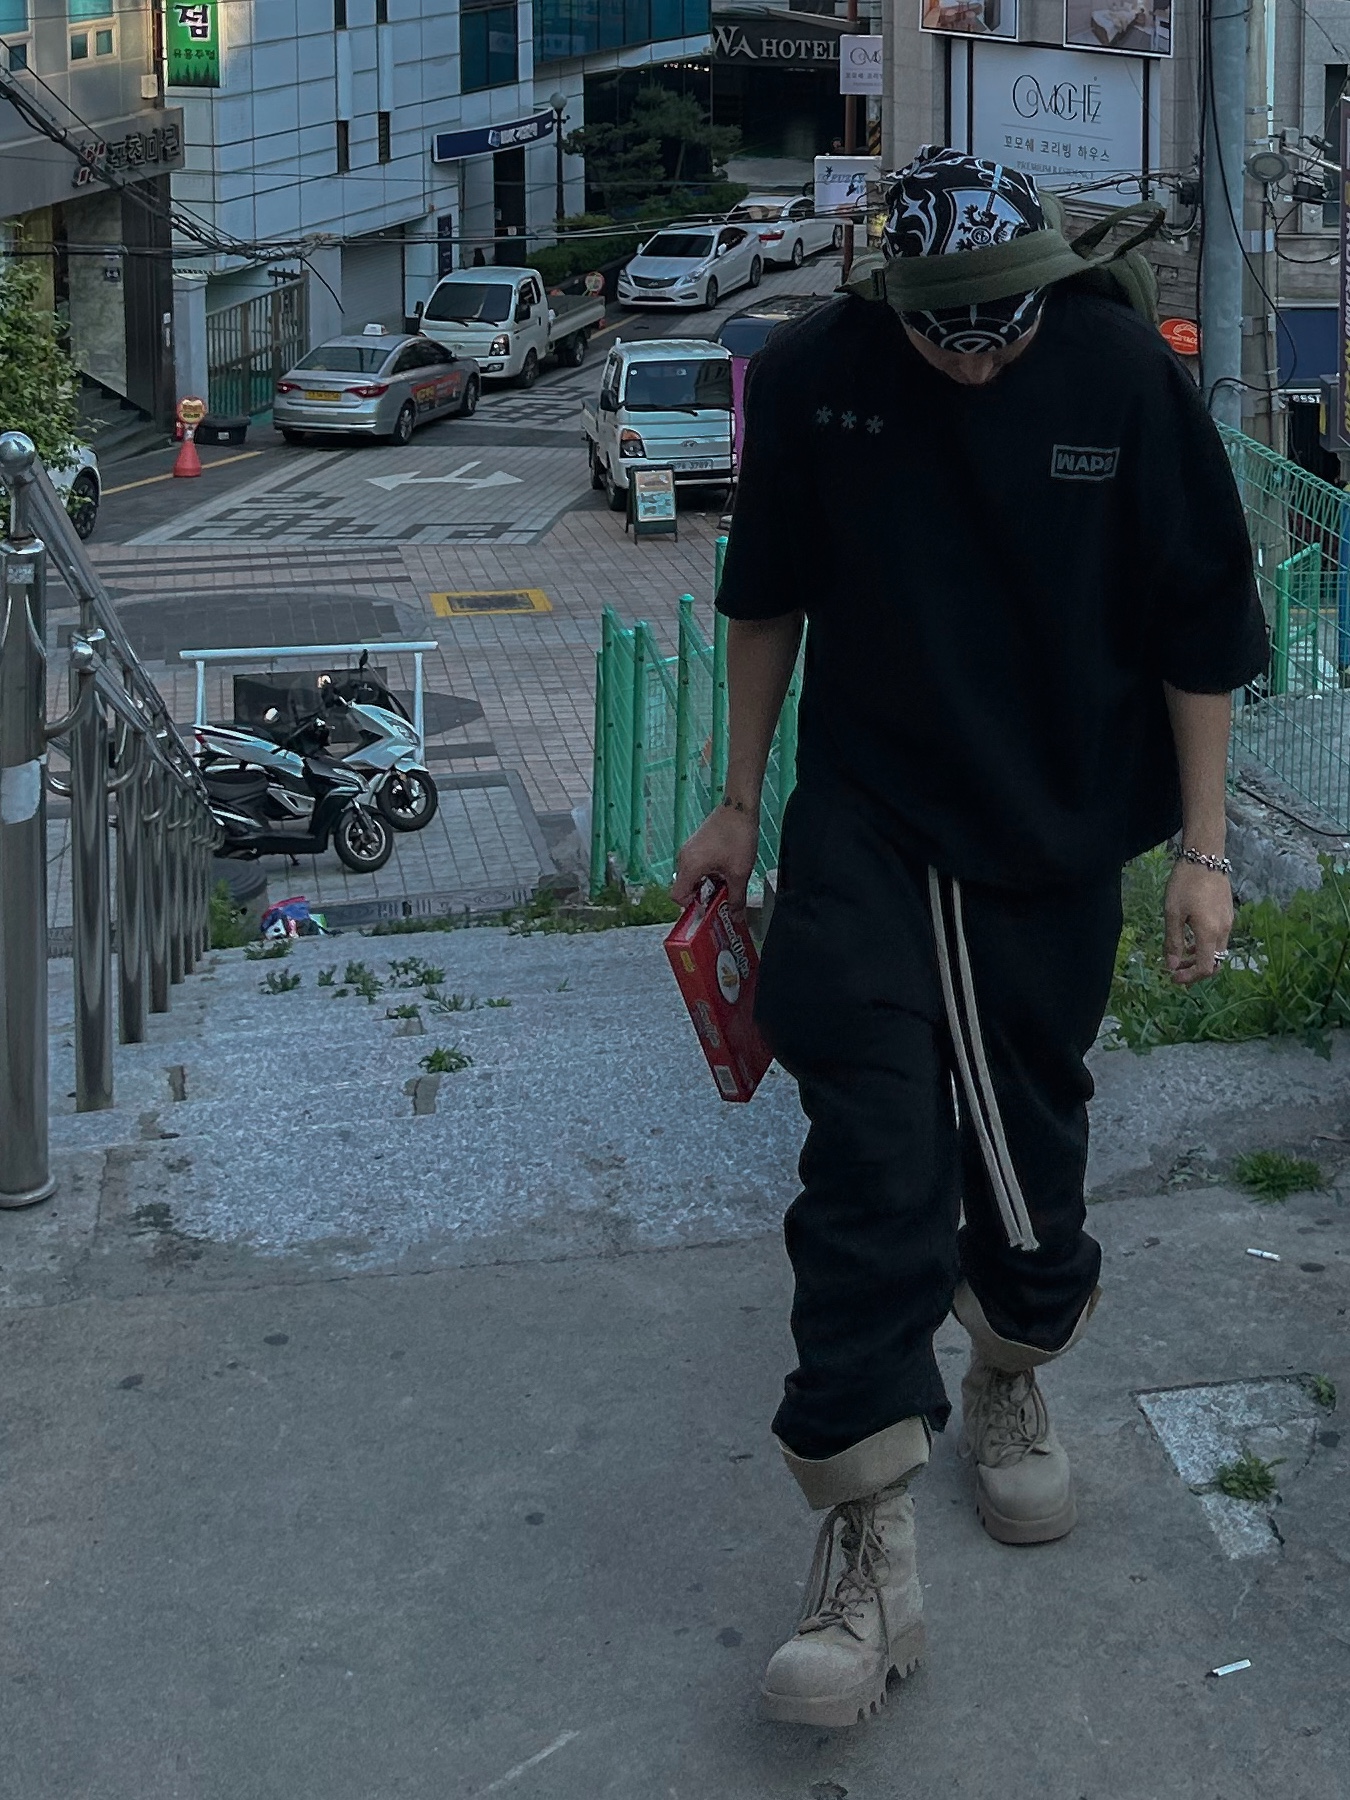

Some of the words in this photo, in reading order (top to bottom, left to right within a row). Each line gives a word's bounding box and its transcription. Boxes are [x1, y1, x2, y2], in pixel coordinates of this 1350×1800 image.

[711, 25, 759, 59] WA
[761, 38, 840, 60] HOTEL
[1004, 135, 1034, 152] 꼬모쉐
[1040, 140, 1072, 158] 코리빙
[1078, 146, 1109, 162] 하우스
